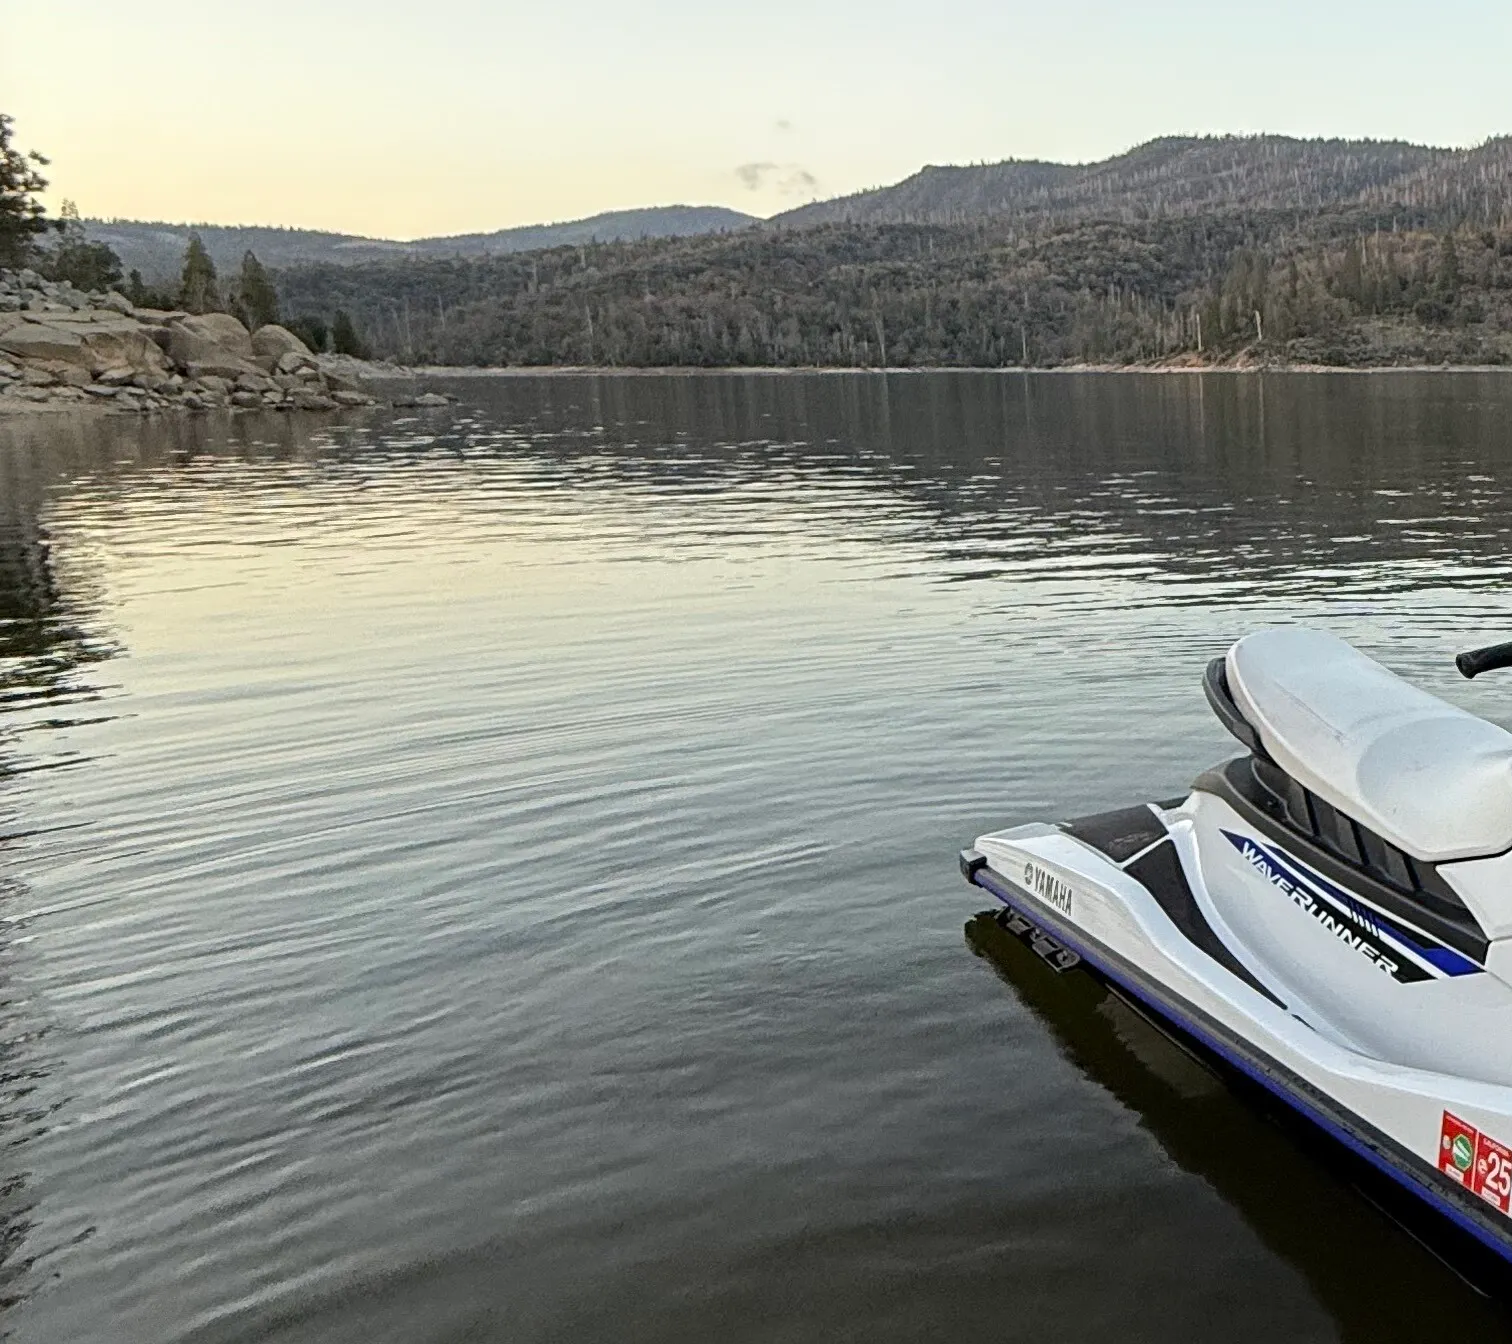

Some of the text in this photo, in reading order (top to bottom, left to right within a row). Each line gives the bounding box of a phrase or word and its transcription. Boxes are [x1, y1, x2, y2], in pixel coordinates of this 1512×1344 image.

[1034, 866, 1072, 916] YAMAHA
[1242, 841, 1399, 976] WAVERUNNER
[1485, 1151, 1512, 1196] 25
